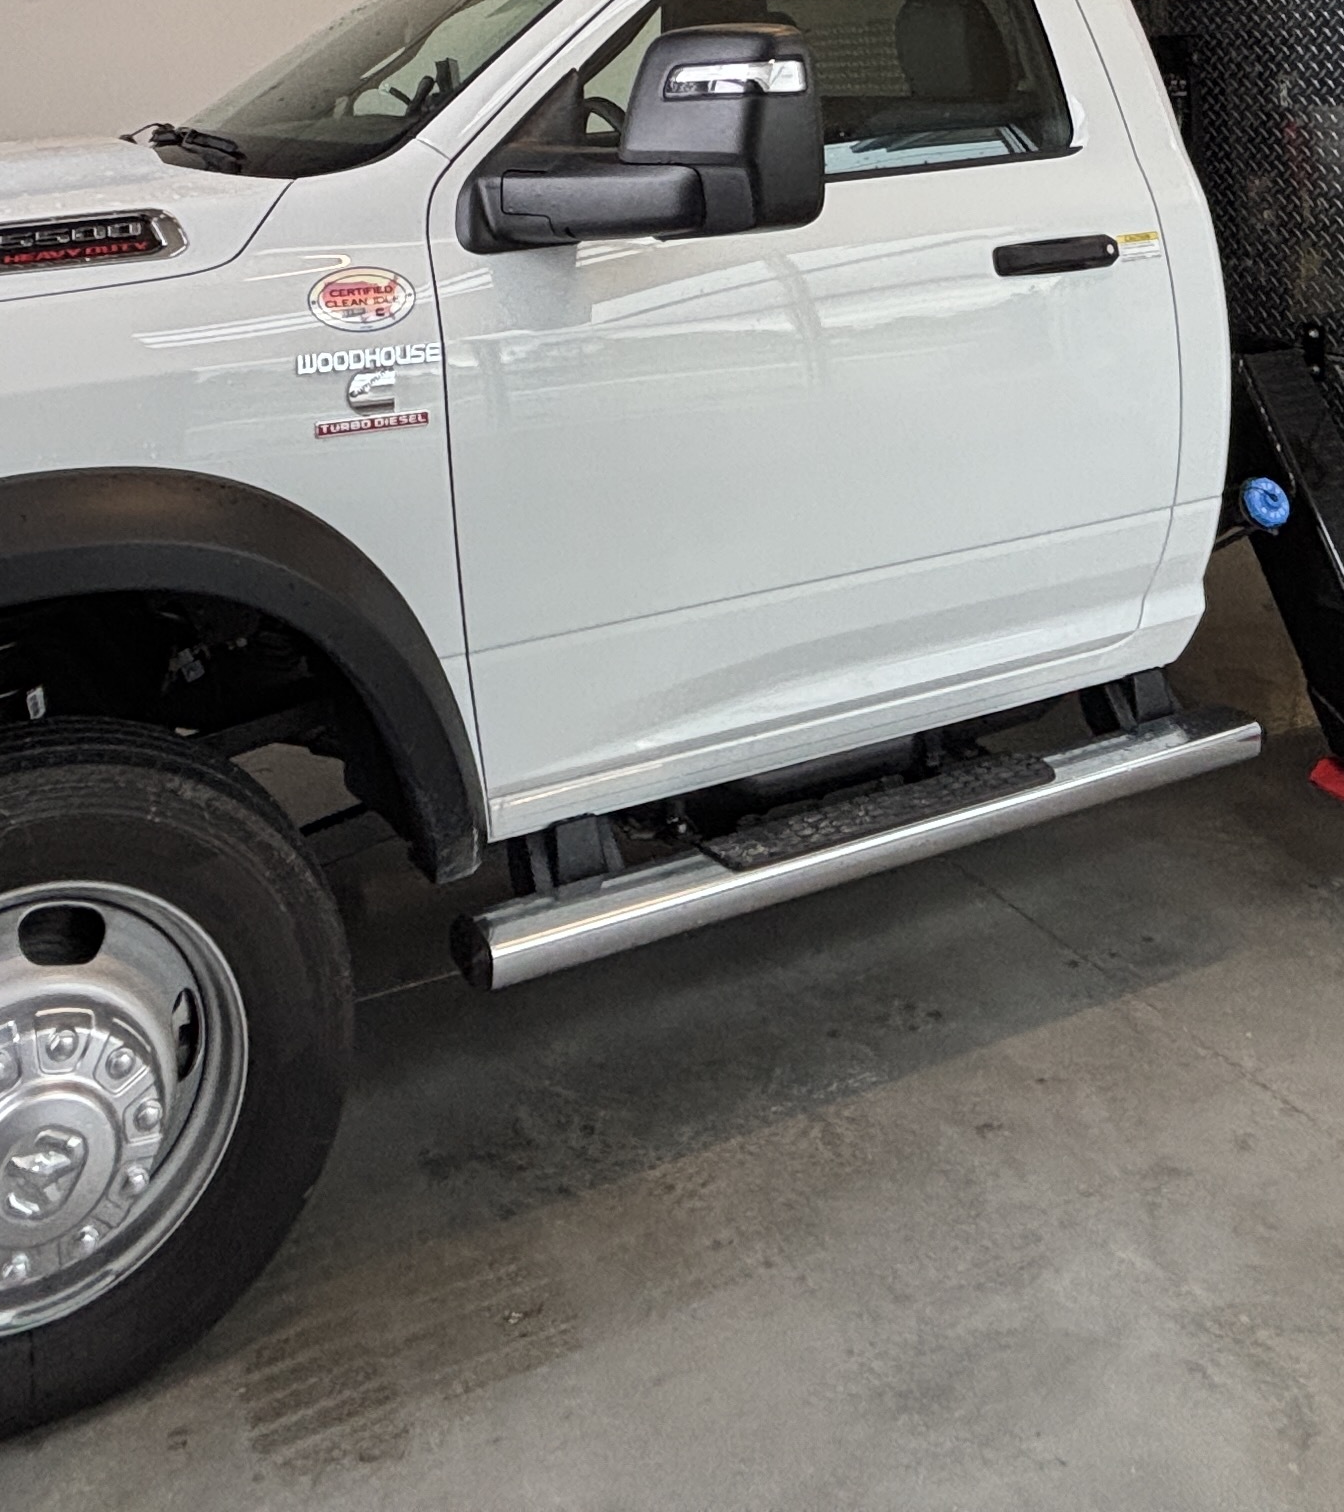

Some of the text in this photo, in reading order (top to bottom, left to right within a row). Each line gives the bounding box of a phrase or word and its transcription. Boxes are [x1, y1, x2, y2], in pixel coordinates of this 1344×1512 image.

[3, 240, 149, 264] HEAVY DUTY
[324, 297, 368, 309] CLEAN
[328, 285, 394, 298] CERTIFIED
[296, 341, 442, 376] WOODHOUSE
[319, 411, 429, 435] TURBO DIESEL
